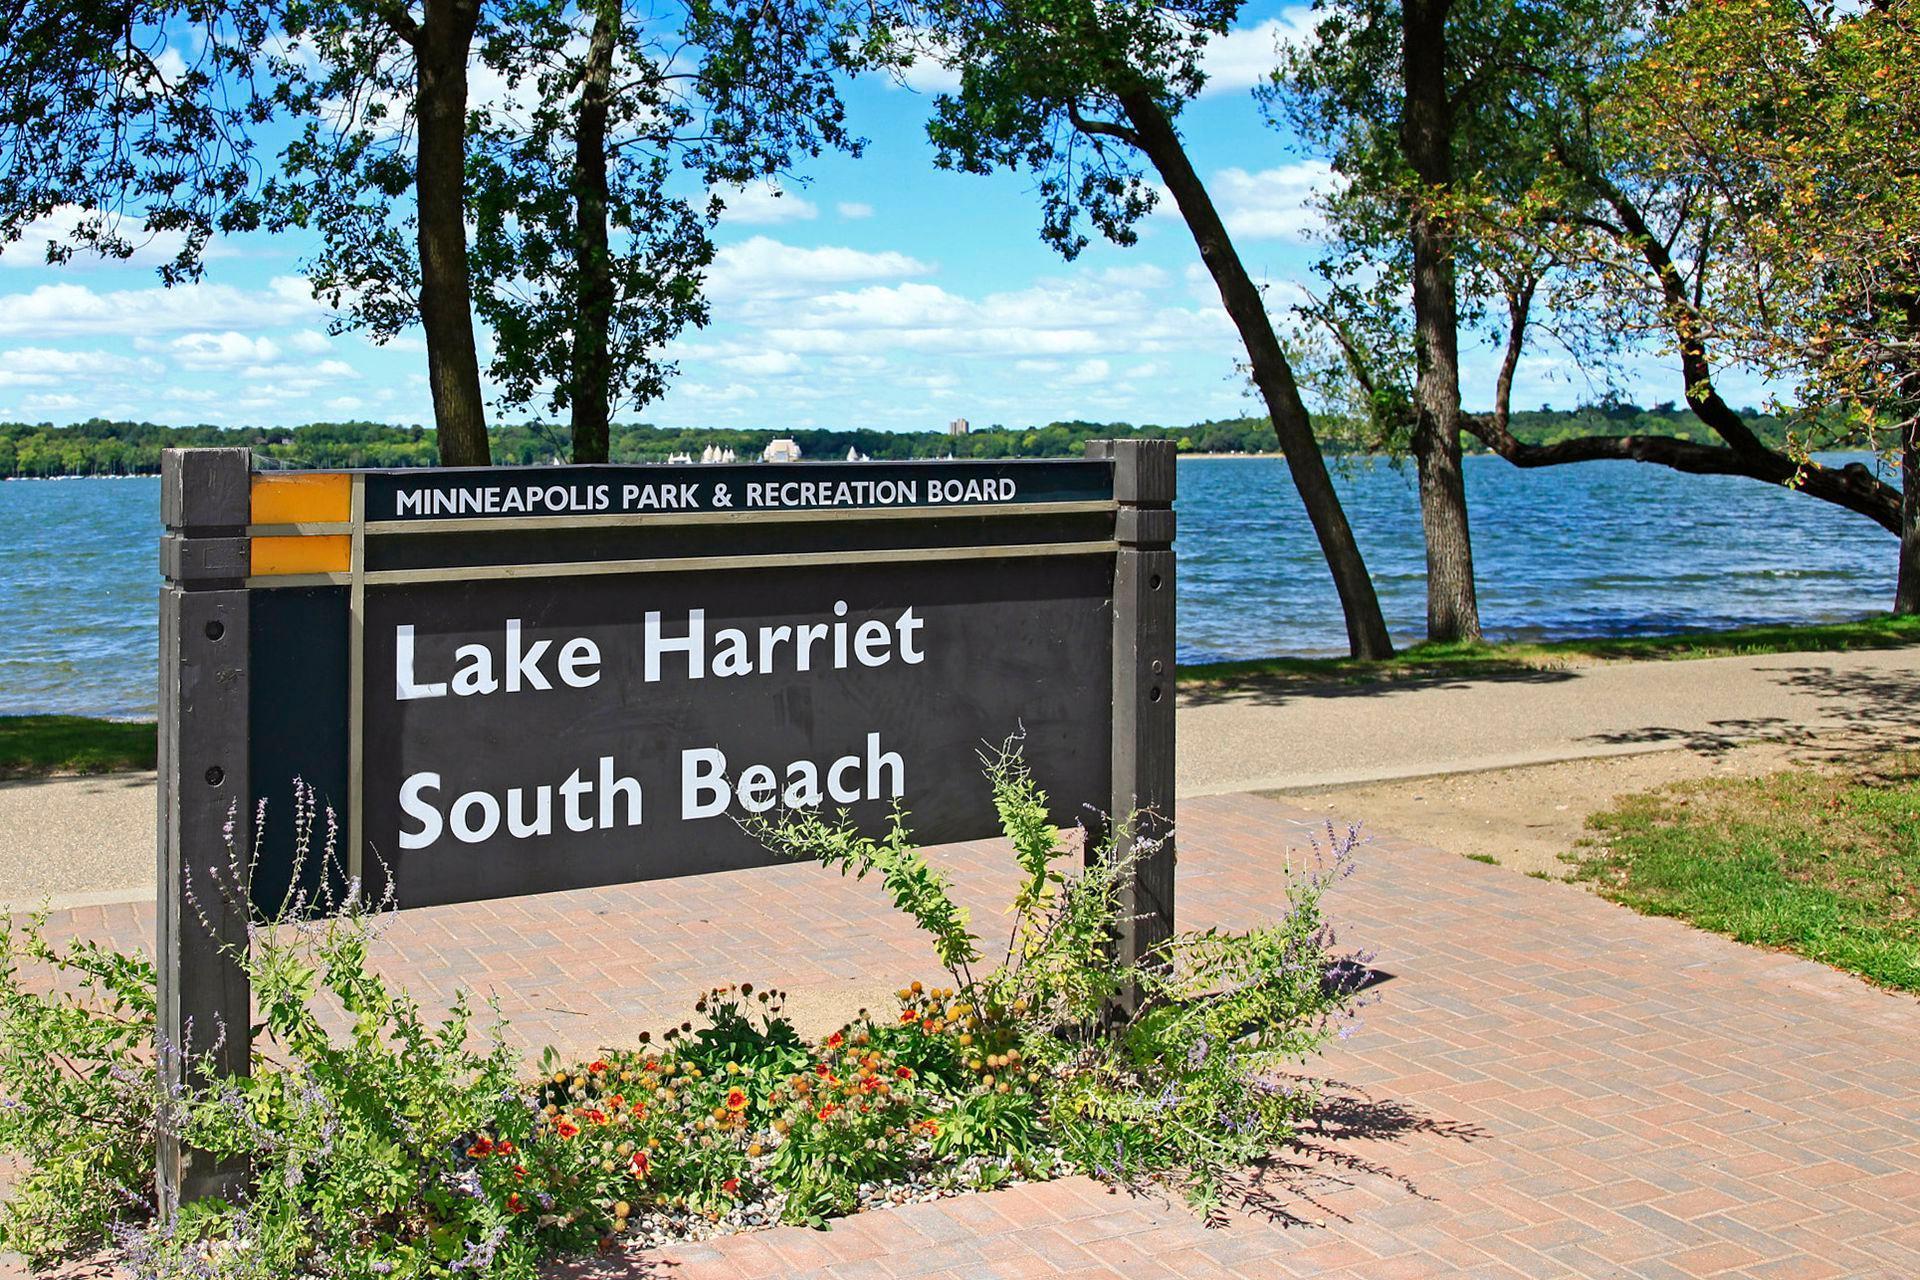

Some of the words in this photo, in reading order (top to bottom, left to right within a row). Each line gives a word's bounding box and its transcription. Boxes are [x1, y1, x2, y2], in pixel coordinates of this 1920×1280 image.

[396, 485, 610, 516] MINNEAPOLIS
[622, 484, 700, 511] PARK
[711, 482, 734, 508] &
[746, 480, 917, 508] RECREATION
[926, 479, 1017, 504] BOARD
[396, 619, 602, 701] Lake
[644, 601, 925, 683] Harriet
[399, 756, 643, 849] South
[682, 732, 905, 820] Beach
